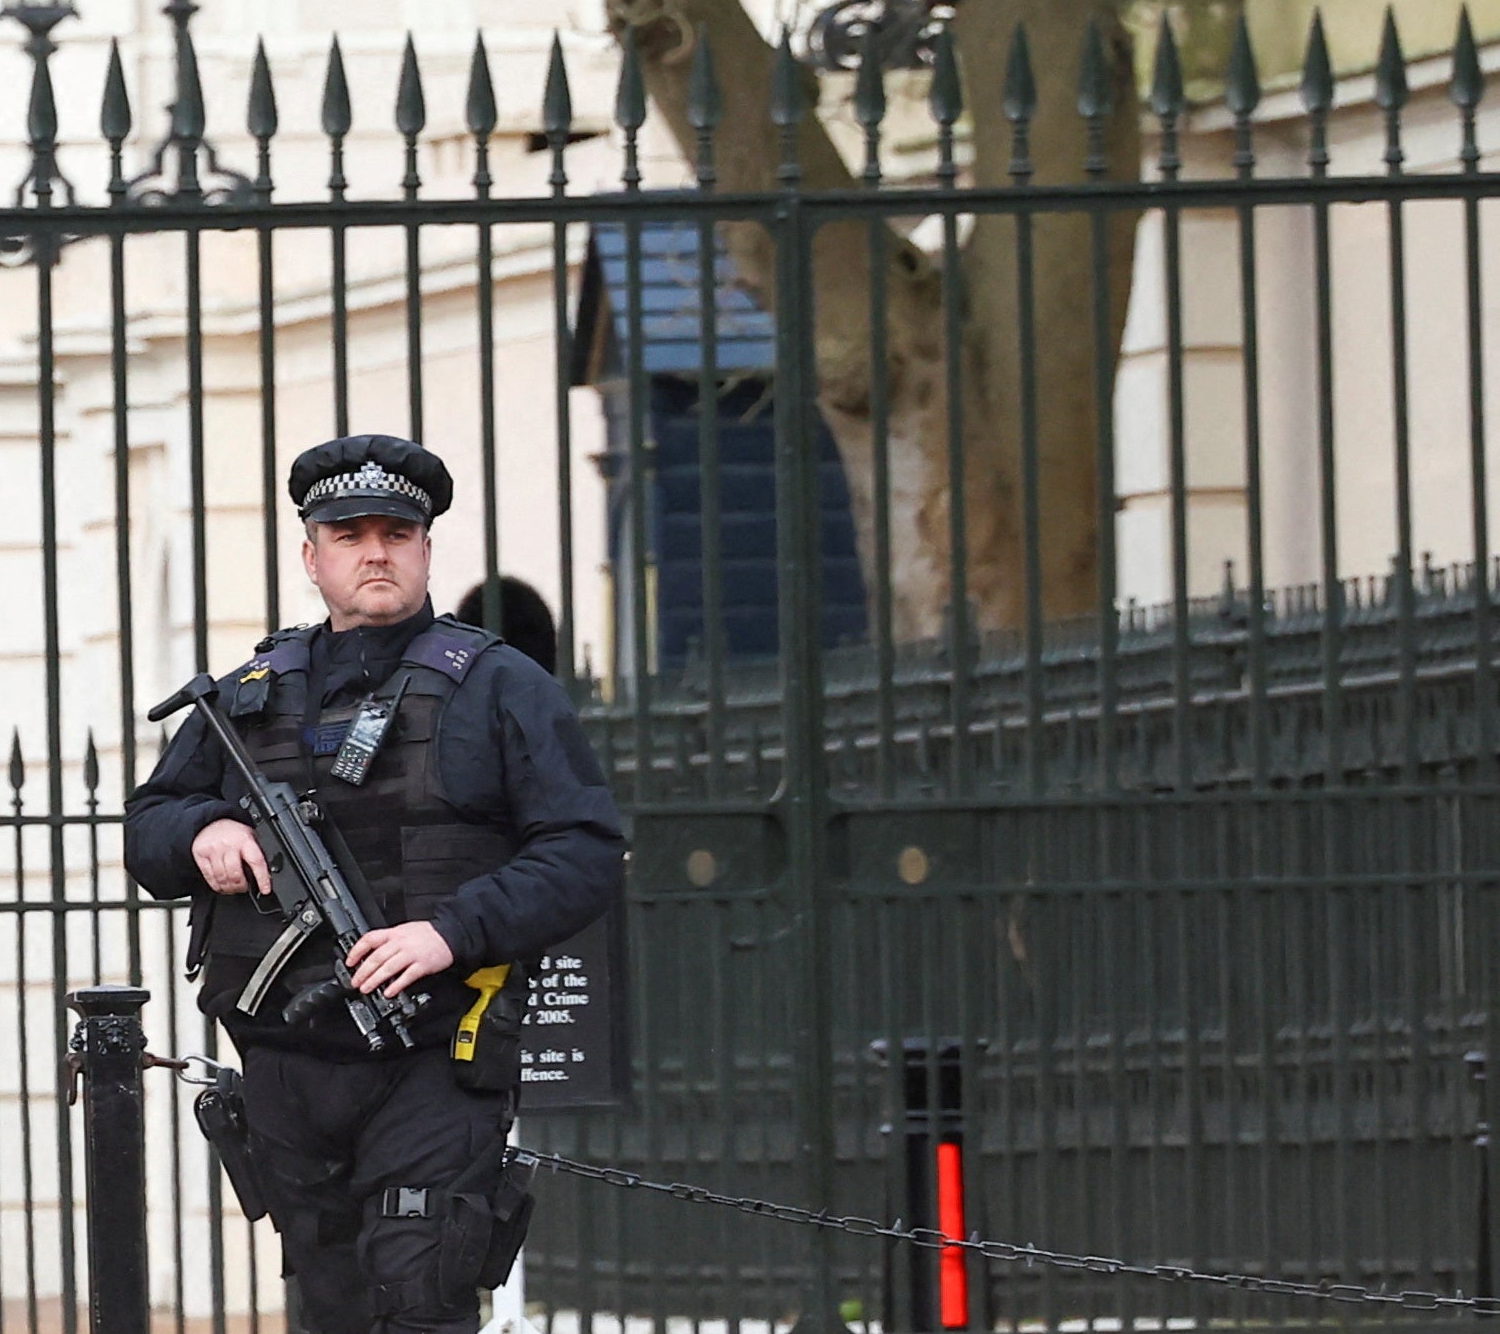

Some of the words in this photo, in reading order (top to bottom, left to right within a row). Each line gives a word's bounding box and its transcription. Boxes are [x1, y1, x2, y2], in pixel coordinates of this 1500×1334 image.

[555, 956, 582, 970] site
[542, 974, 559, 988] of
[564, 973, 588, 987] the
[543, 992, 589, 1006] Crime
[536, 1010, 576, 1025] 2005.
[520, 1050, 534, 1064] is
[539, 1049, 566, 1063] site
[571, 1048, 585, 1062] is
[520, 1068, 569, 1082] ffence.
